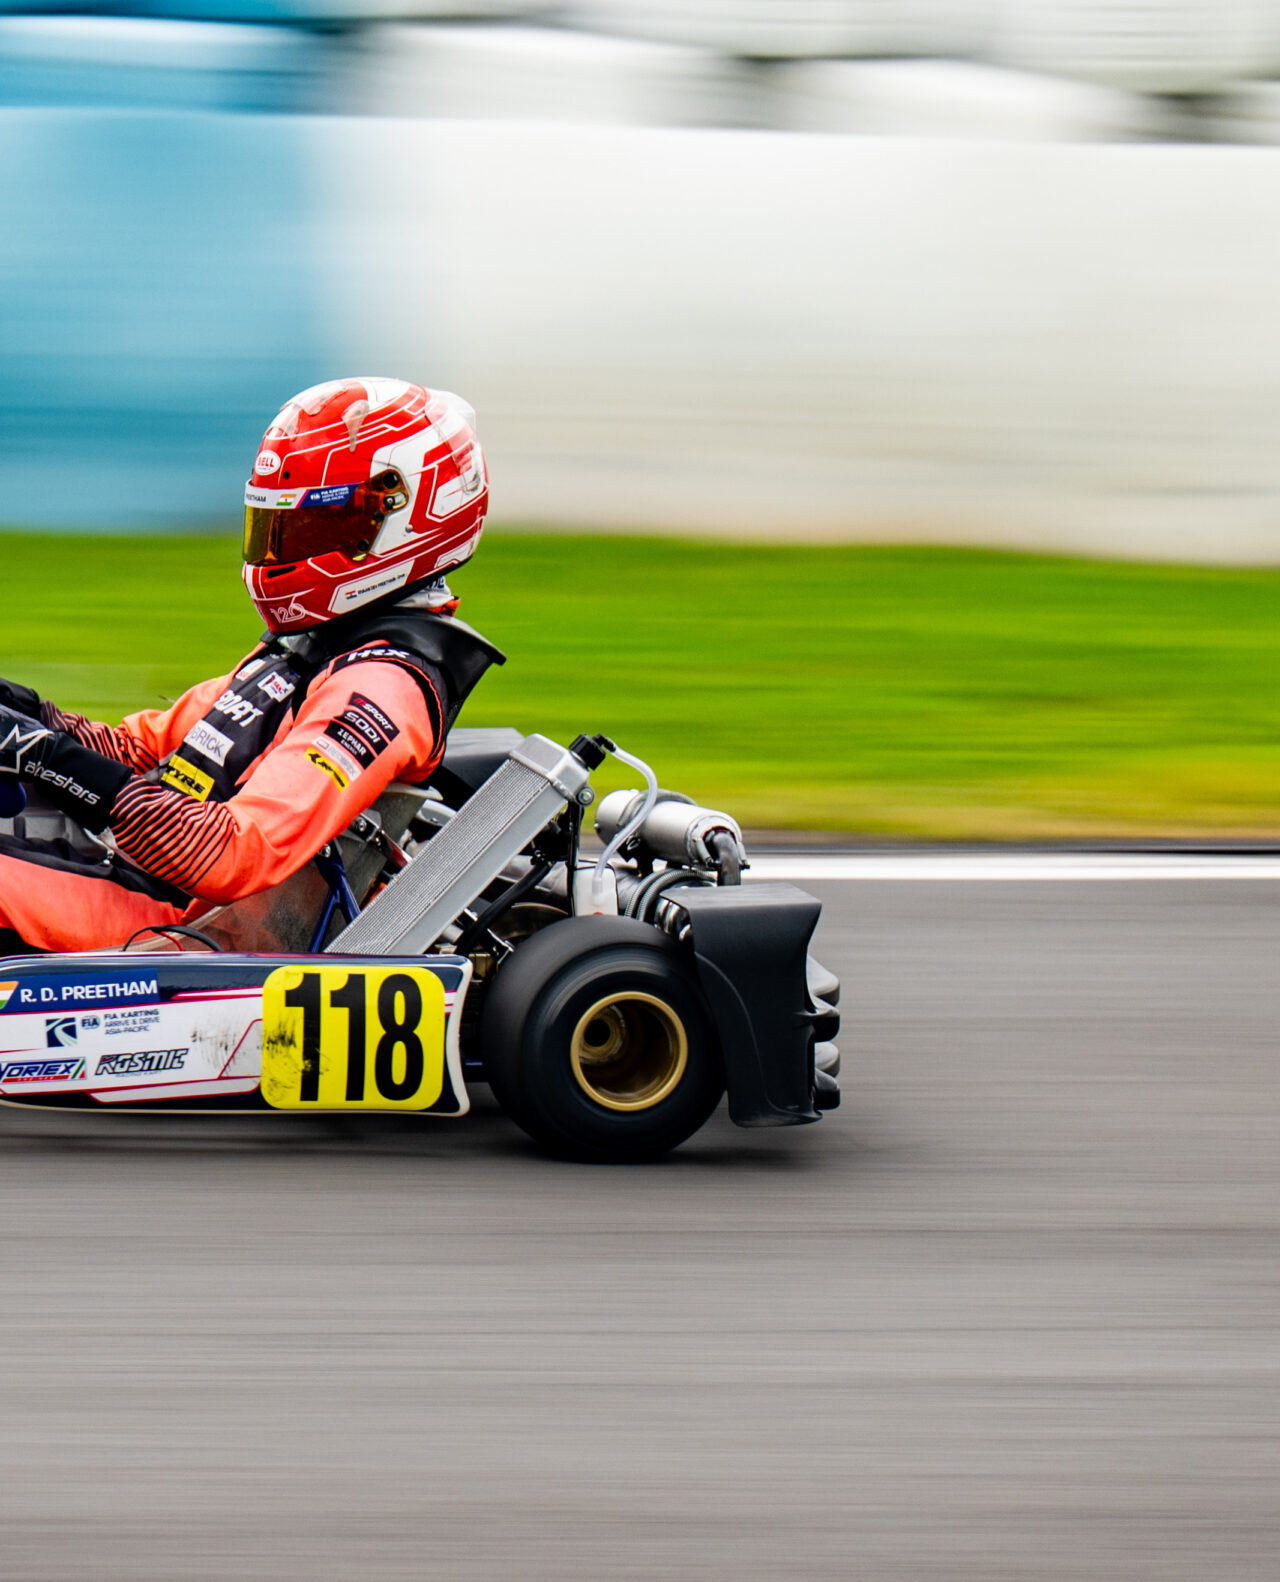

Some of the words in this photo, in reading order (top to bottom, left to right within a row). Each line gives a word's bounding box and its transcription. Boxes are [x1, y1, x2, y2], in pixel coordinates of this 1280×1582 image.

[257, 456, 275, 468] BELL
[347, 648, 410, 662] HRX
[344, 711, 381, 744] SODI
[337, 727, 368, 756] ZEPHAR
[20, 988, 36, 1003] R.
[41, 987, 58, 1002] D.
[62, 980, 158, 1000] PREETHAM
[81, 1018, 100, 1028] FIA
[121, 1009, 159, 1018] KARTING
[285, 972, 424, 1102] 118
[95, 1048, 189, 1076] KOSMIC
